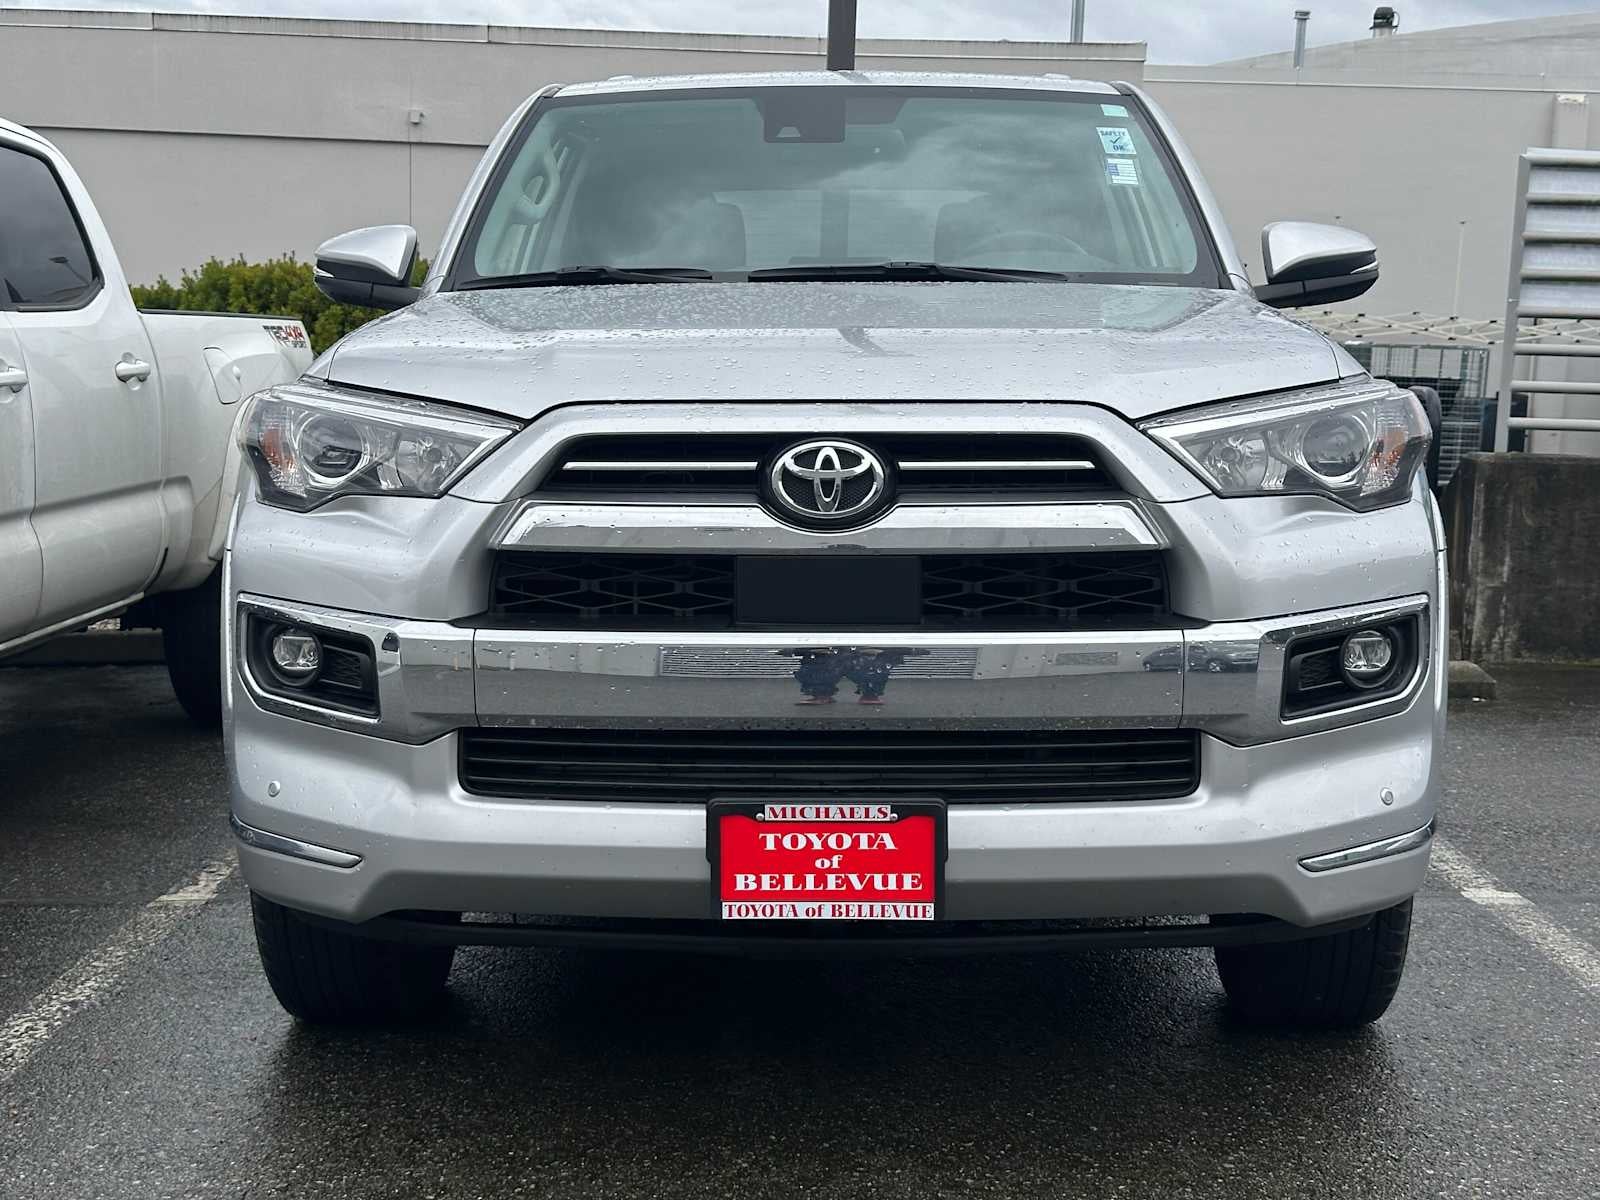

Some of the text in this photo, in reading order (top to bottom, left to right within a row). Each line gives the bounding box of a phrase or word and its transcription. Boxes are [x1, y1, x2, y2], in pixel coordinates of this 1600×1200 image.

[767, 806, 889, 819] MICHAELS
[759, 832, 898, 850] TOYOTA
[814, 854, 843, 869] of
[734, 873, 923, 891] BELLEVUE
[724, 904, 933, 918] TOYOTA of BELLEVUE
